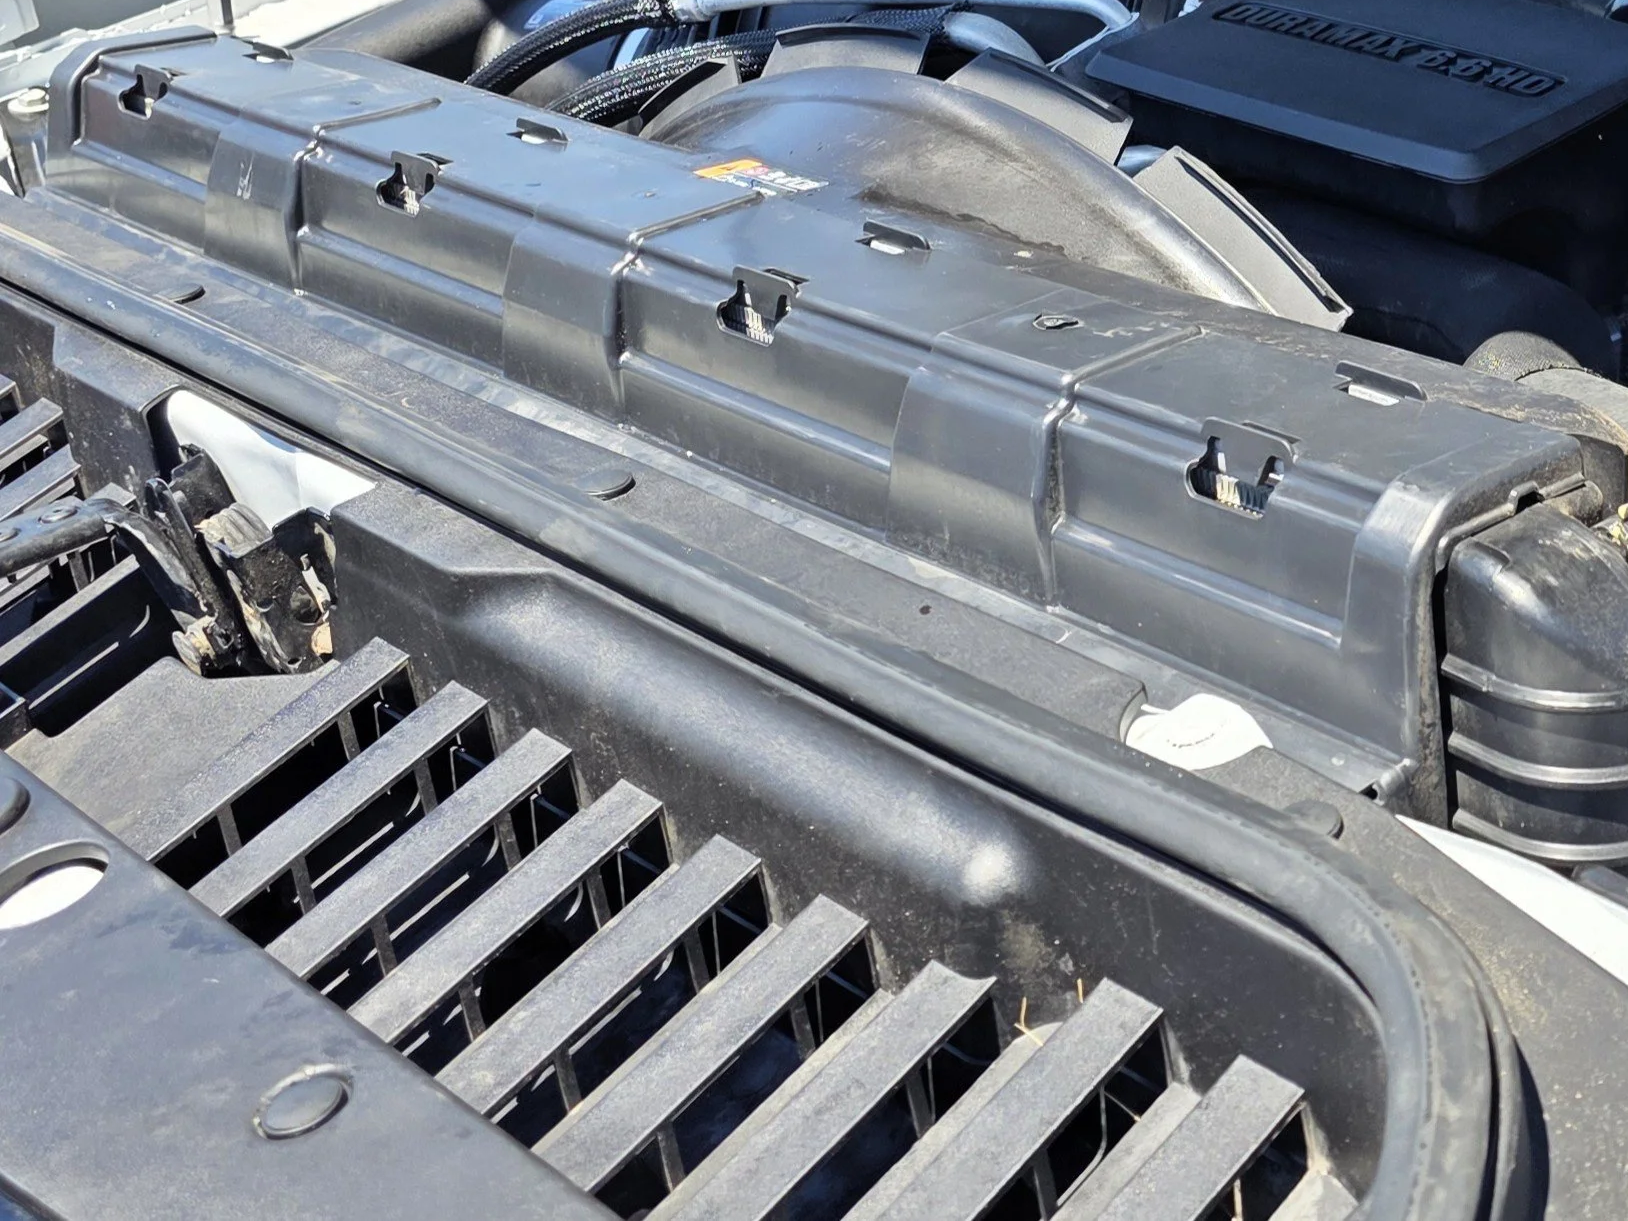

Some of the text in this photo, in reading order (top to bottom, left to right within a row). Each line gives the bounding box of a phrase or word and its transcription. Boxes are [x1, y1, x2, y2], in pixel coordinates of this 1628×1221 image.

[1218, 3, 1560, 97] DURAMAX 6.6 HD
